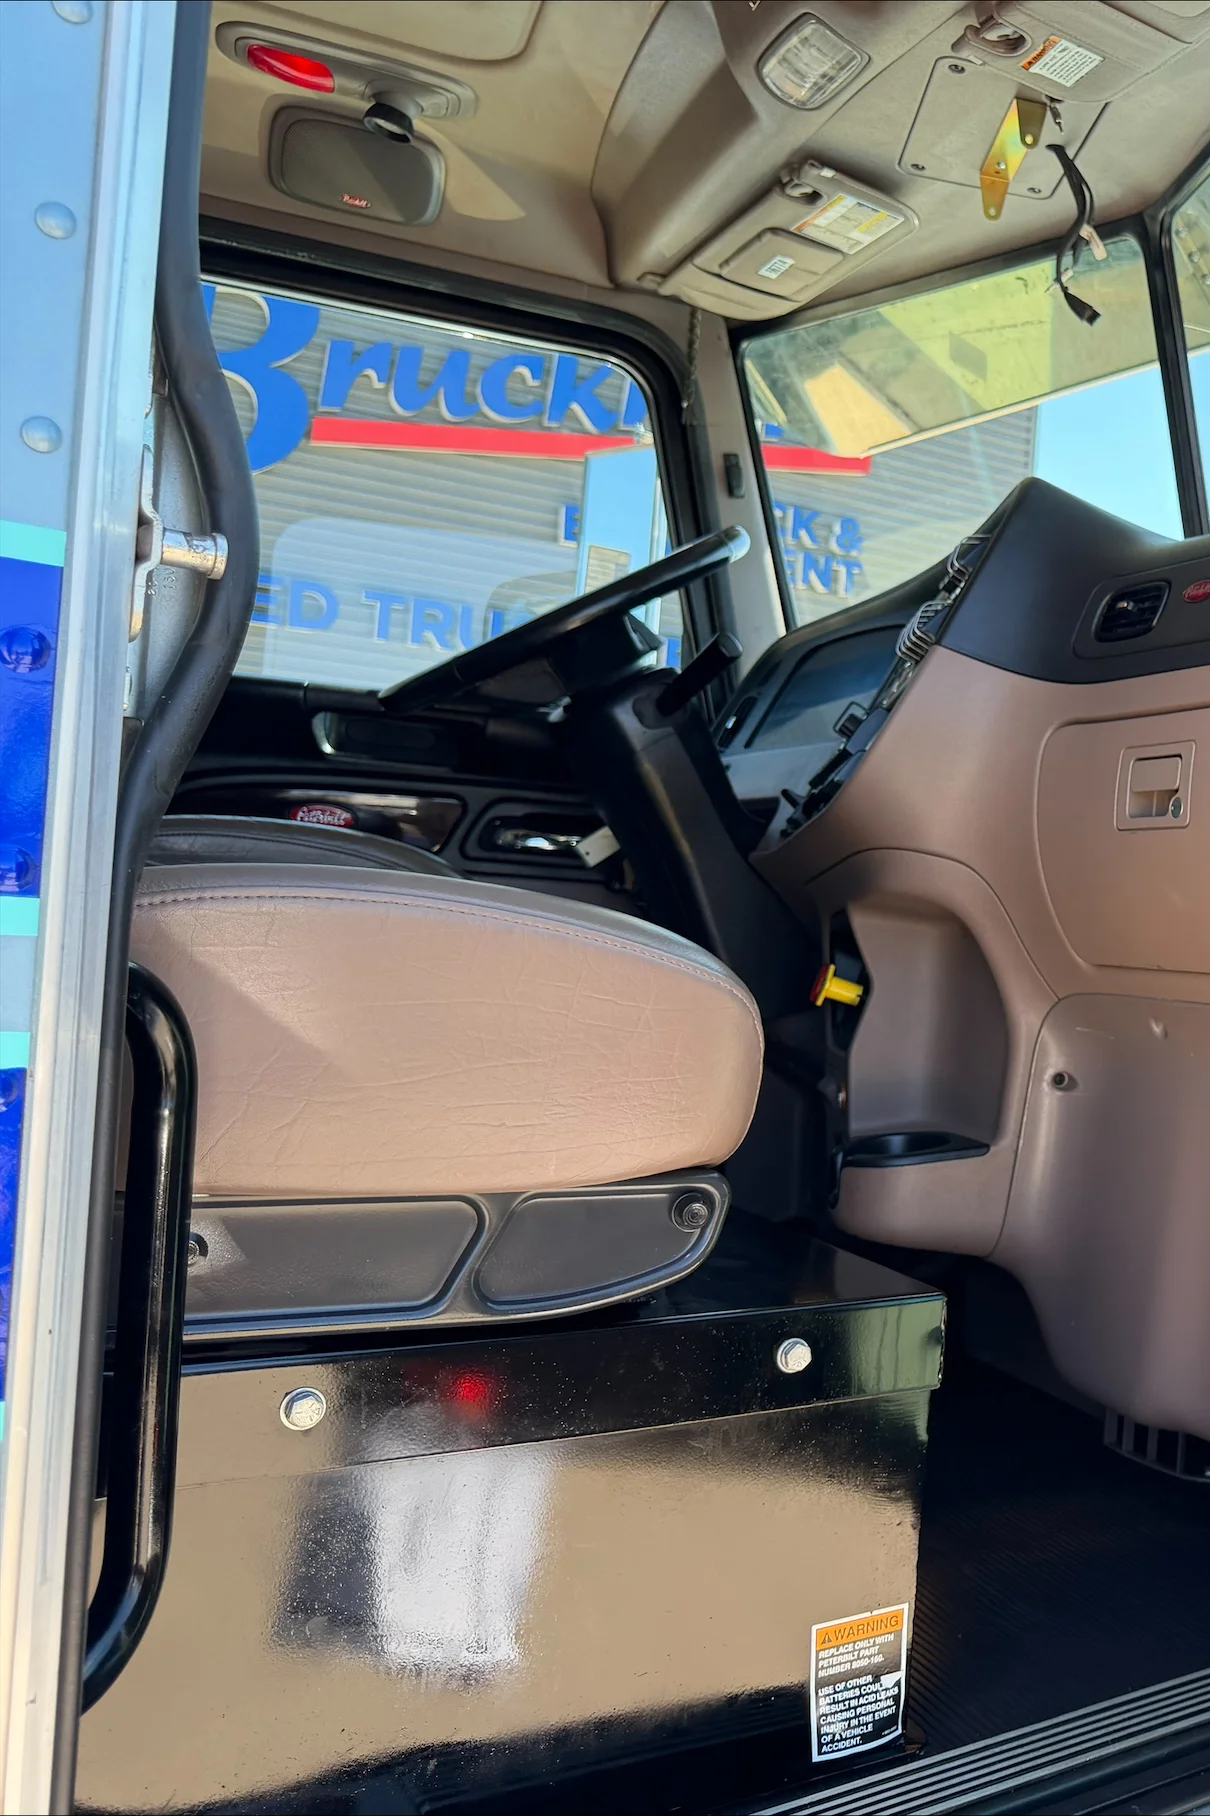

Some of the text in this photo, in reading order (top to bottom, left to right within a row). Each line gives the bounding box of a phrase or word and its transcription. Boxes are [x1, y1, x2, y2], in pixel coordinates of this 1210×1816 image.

[200, 283, 648, 475] Bruck
[828, 517, 865, 557] &
[361, 589, 535, 651] TRU
[834, 1615, 899, 1641] WARNING
[818, 1633, 895, 1659] REPLACE ONLY WITH
[818, 1646, 879, 1668] PETERBILT PART
[818, 1662, 851, 1678] NUMBER
[818, 1674, 873, 1696] USE OF OTHER
[819, 1681, 886, 1706] BATTERIES COUL
[820, 1686, 899, 1715] RESULT IN ACID LEAKS
[820, 1697, 895, 1724] CAUSING PERSONAL
[820, 1705, 897, 1734] INJURY IN THE EVENT
[821, 1734, 833, 1744] OF
[834, 1732, 841, 1741] A
[841, 1723, 873, 1739] VEHICLE
[821, 1736, 863, 1753] ACCIDENT.
